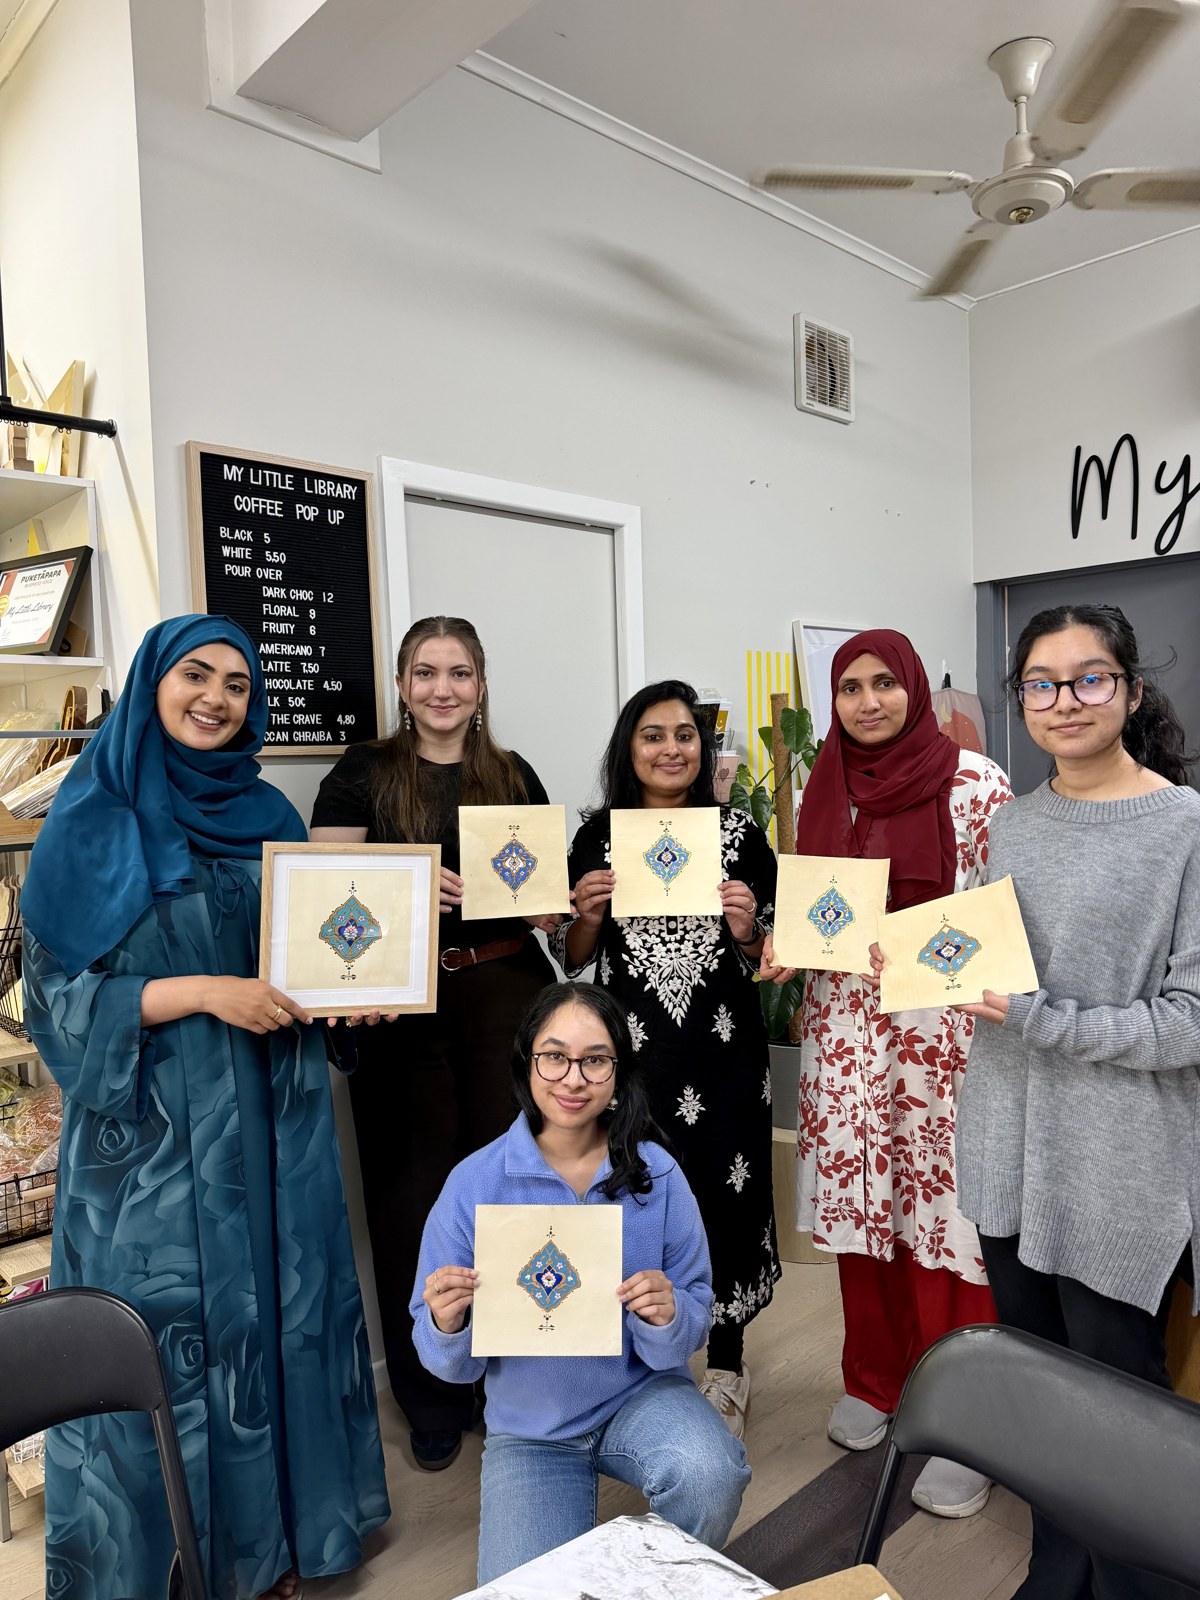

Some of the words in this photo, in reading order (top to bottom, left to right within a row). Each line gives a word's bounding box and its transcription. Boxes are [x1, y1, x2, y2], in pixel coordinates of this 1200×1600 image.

[223, 464, 244, 482] MY
[250, 468, 294, 490] LITTLE
[304, 477, 357, 500] LIBRARY
[1071, 433, 1200, 555] My
[234, 495, 283, 517] COFFEE
[296, 504, 319, 521] POP
[328, 509, 345, 525] UP
[219, 526, 253, 542] BLACK
[263, 533, 271, 544] 5
[222, 545, 252, 559] WHITE
[225, 564, 251, 577] POUR
[256, 568, 283, 580] OVER
[262, 586, 287, 598] DARK
[289, 589, 314, 601] CHOC
[323, 592, 334, 603] 12
[262, 603, 299, 617] FLORAL
[309, 608, 316, 620] 9
[262, 621, 295, 634] FRUITY
[309, 625, 316, 635] 6
[259, 643, 312, 656] AMERICANO
[319, 646, 326, 657] 7
[261, 661, 291, 672] LATTE
[265, 678, 314, 690] HOCOLATE
[288, 697, 306, 708] 50¢
[271, 714, 290, 725] THE
[293, 714, 322, 725] CRAVE
[293, 731, 332, 742] GHRAIBA
[340, 731, 346, 741] 3
